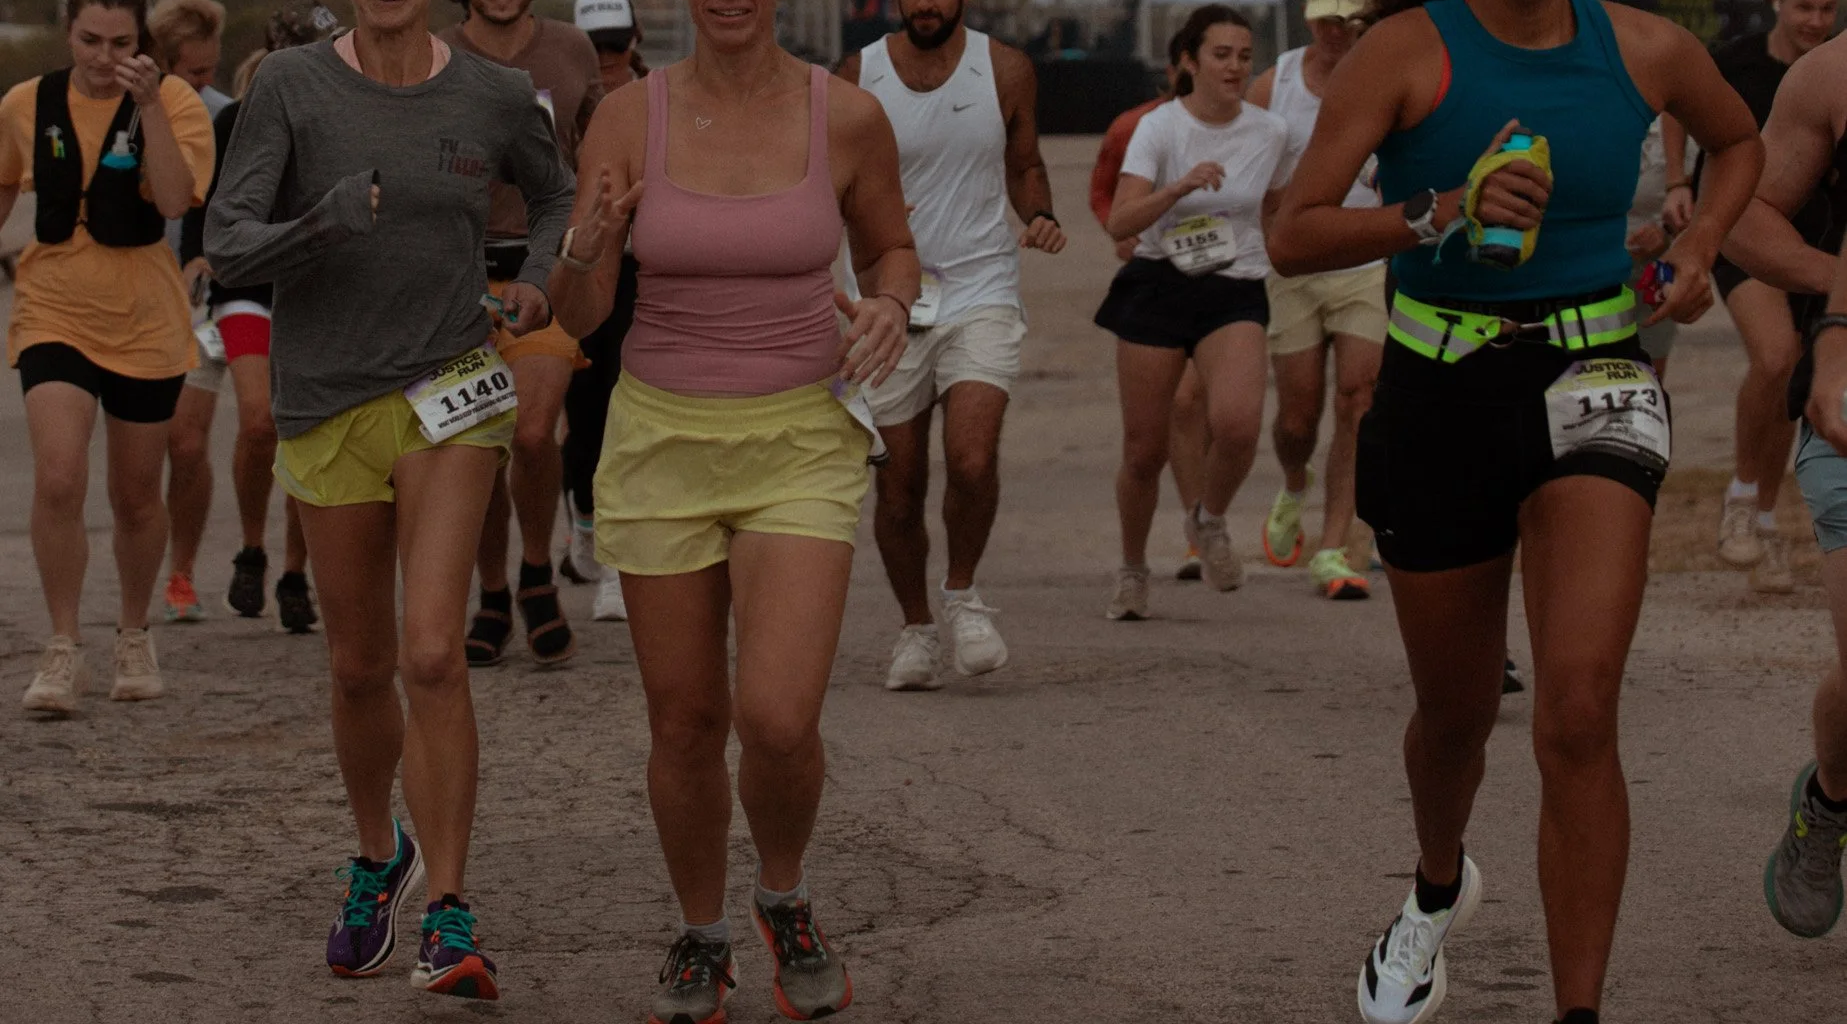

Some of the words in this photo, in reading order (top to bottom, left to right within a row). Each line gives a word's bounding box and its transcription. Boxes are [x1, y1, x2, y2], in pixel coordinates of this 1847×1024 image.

[429, 351, 481, 381] JUSTICE
[457, 359, 486, 377] RUN
[1575, 362, 1633, 375] JUSTICE
[1606, 371, 1638, 381] RUN
[440, 371, 509, 414] 1140
